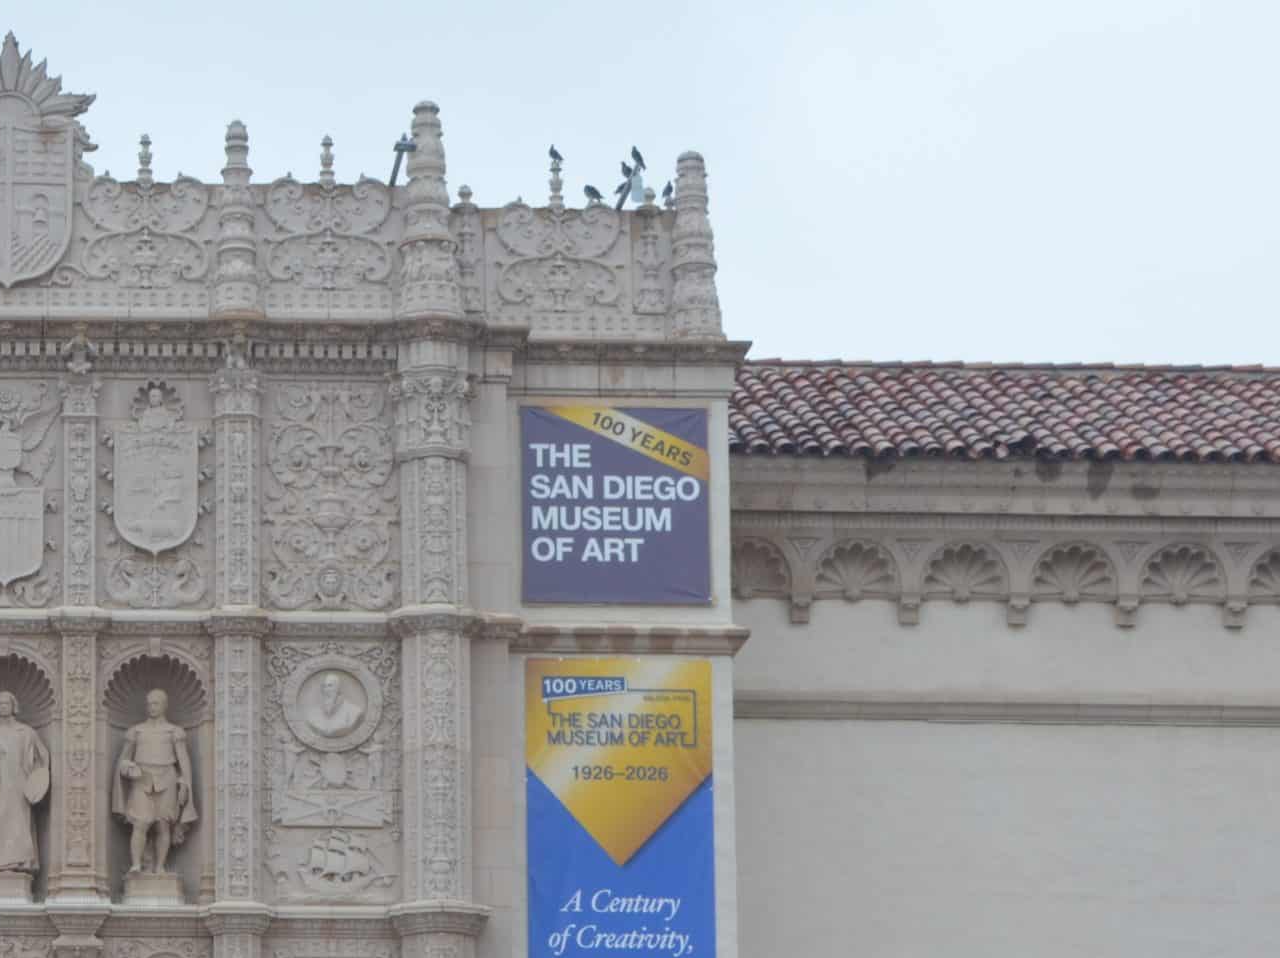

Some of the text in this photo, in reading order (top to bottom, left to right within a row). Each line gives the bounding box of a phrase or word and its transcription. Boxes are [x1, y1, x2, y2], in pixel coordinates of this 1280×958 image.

[592, 412, 693, 467] 100 YEARS
[528, 443, 591, 468] THE
[530, 474, 700, 501] SAN DIEGO
[531, 506, 672, 532] MUSEUM
[531, 537, 644, 562] OF ART
[543, 678, 621, 694] 100 YEARS
[550, 712, 682, 730] THE SAN DIEGO
[547, 730, 688, 747] MUSEUM OF ART
[560, 888, 680, 921] A Century
[548, 924, 693, 957] of Creativity,
